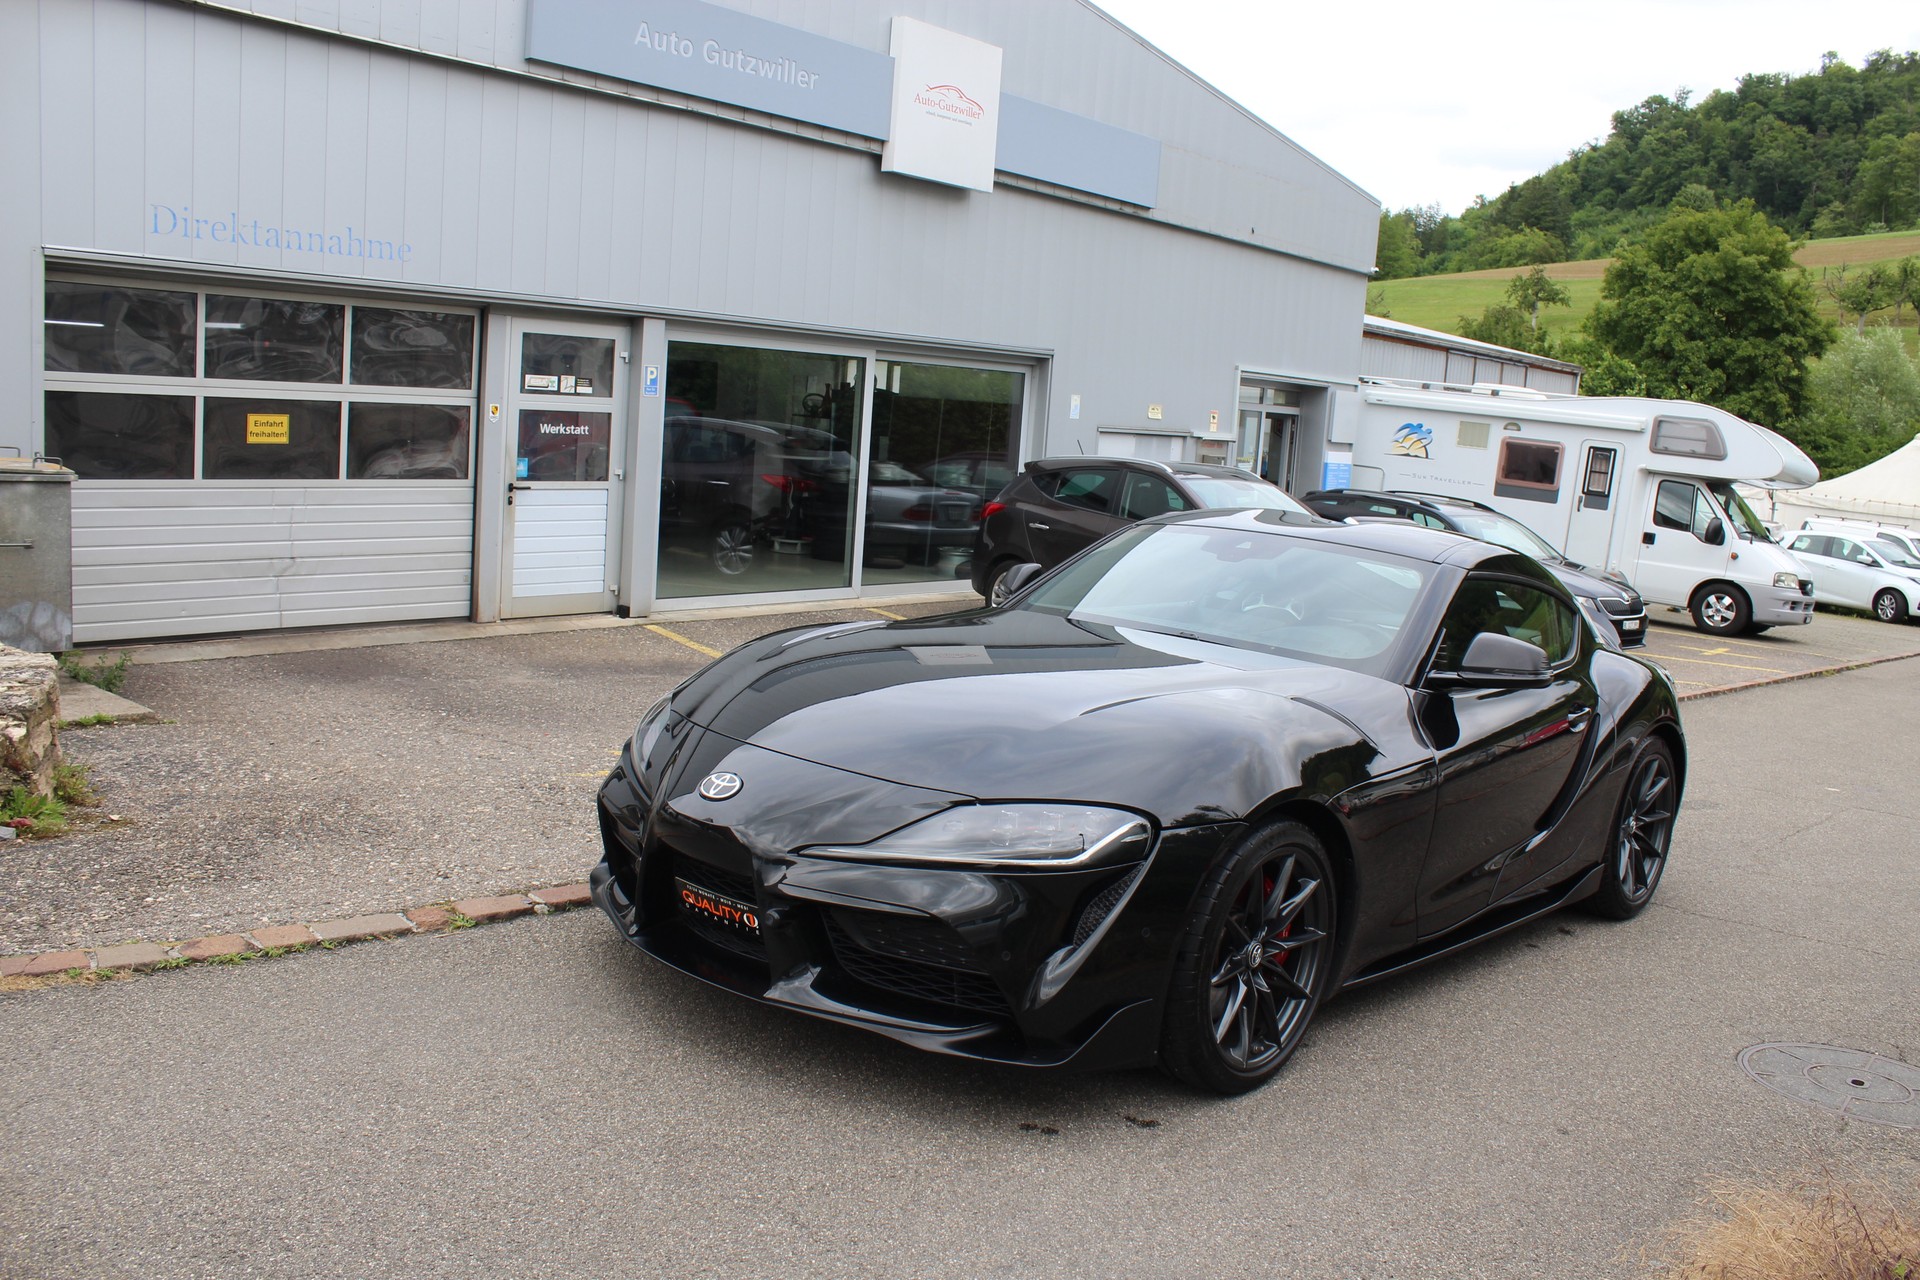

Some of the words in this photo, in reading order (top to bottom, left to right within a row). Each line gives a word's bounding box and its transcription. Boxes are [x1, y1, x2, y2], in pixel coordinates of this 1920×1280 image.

[634, 20, 694, 58] Auto
[703, 38, 820, 90] Gutzwiller
[914, 92, 982, 120] Auto-Gutzwiller
[150, 203, 412, 263] Direktannahme
[646, 366, 658, 386] P
[249, 430, 287, 438] freihalten!
[254, 420, 284, 428] Einfahrt
[540, 423, 589, 435] Werkstatt
[682, 890, 742, 922] QUALITY
[685, 902, 760, 936] GARANTIE
